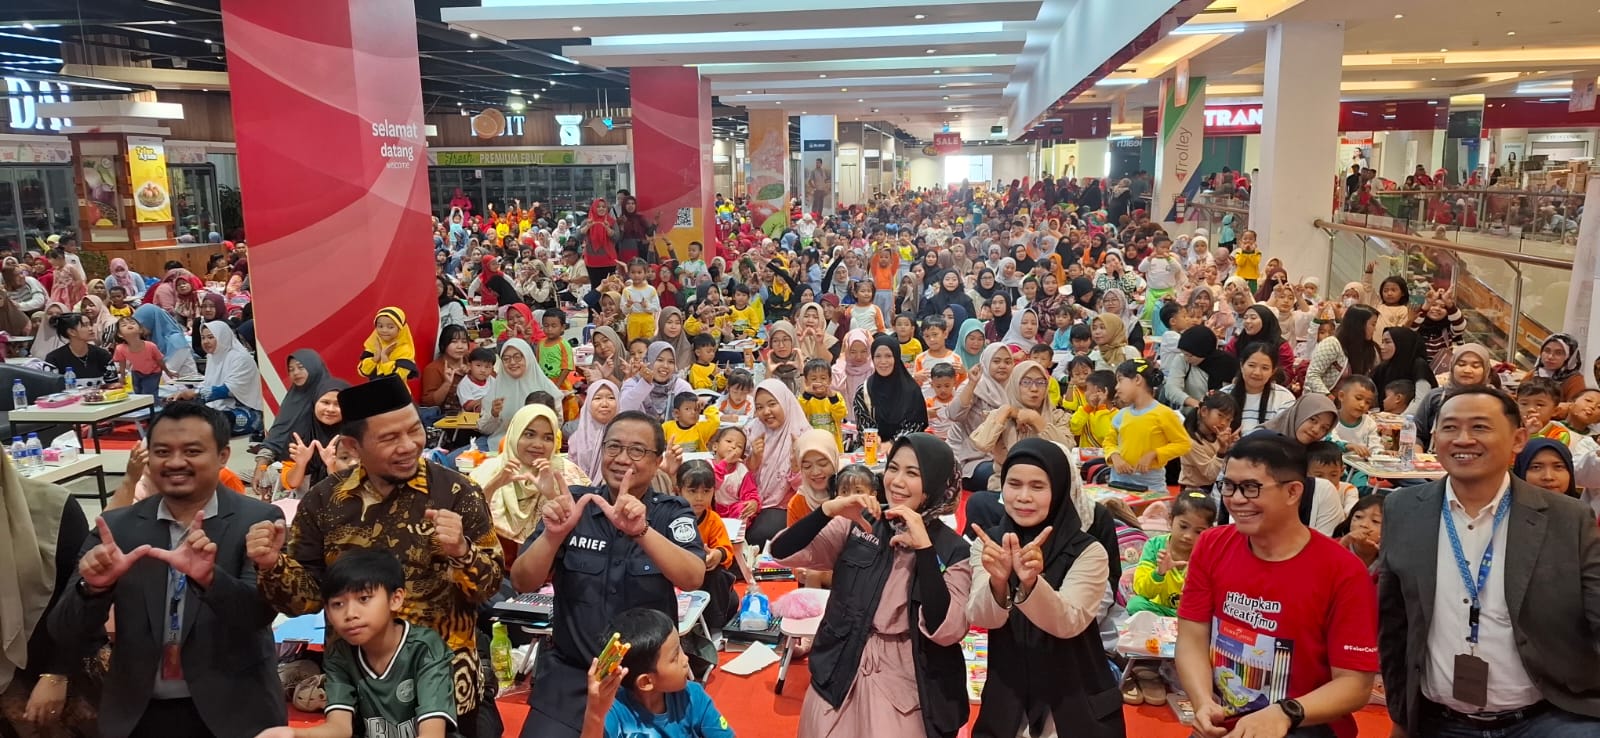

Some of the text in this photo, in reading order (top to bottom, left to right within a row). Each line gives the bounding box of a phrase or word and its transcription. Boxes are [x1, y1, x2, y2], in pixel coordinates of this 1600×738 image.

[372, 119, 418, 139] selamat
[936, 137, 959, 146] SALE
[1175, 127, 1193, 173] Trolley
[381, 142, 414, 161] datang
[480, 152, 519, 164] PREMIUM
[520, 152, 545, 164] FRUIT
[569, 535, 607, 551] ARIEF
[1226, 591, 1281, 612] Hidupkan
[1223, 602, 1276, 631] Kreatifmu
